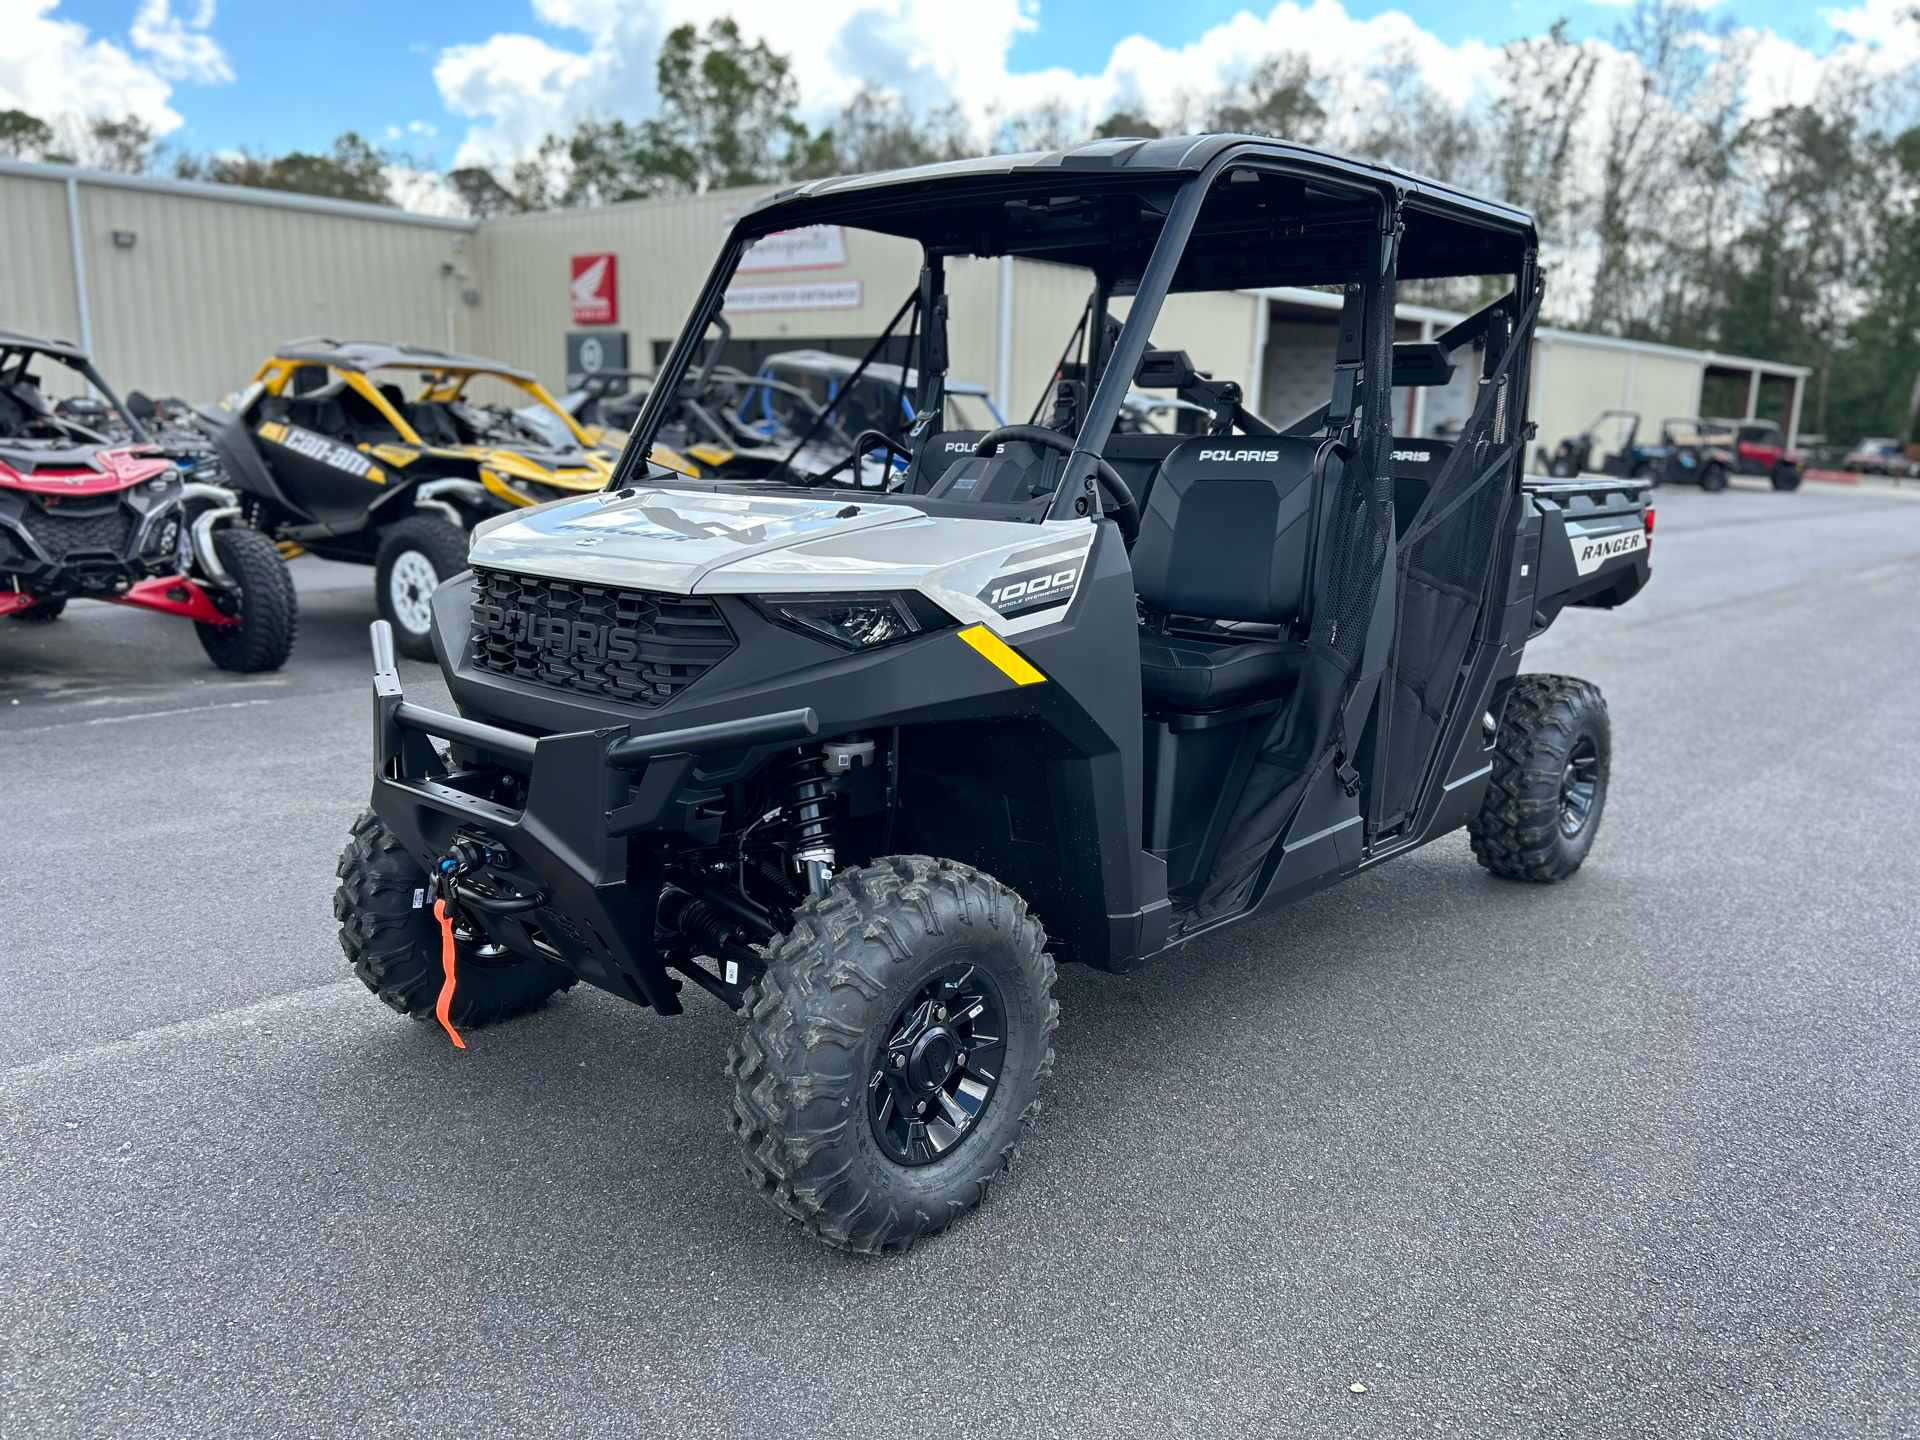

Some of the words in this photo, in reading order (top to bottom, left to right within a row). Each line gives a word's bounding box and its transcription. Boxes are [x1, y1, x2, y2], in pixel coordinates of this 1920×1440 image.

[945, 442, 1005, 454] POLAS
[1199, 450, 1280, 462] POLARIS
[1390, 451, 1431, 462] ARIS
[1580, 534, 1640, 562] RANGER
[990, 568, 1077, 605] 1000
[1024, 588, 1060, 602] OVERHEAD
[484, 604, 640, 663] POLARIS
